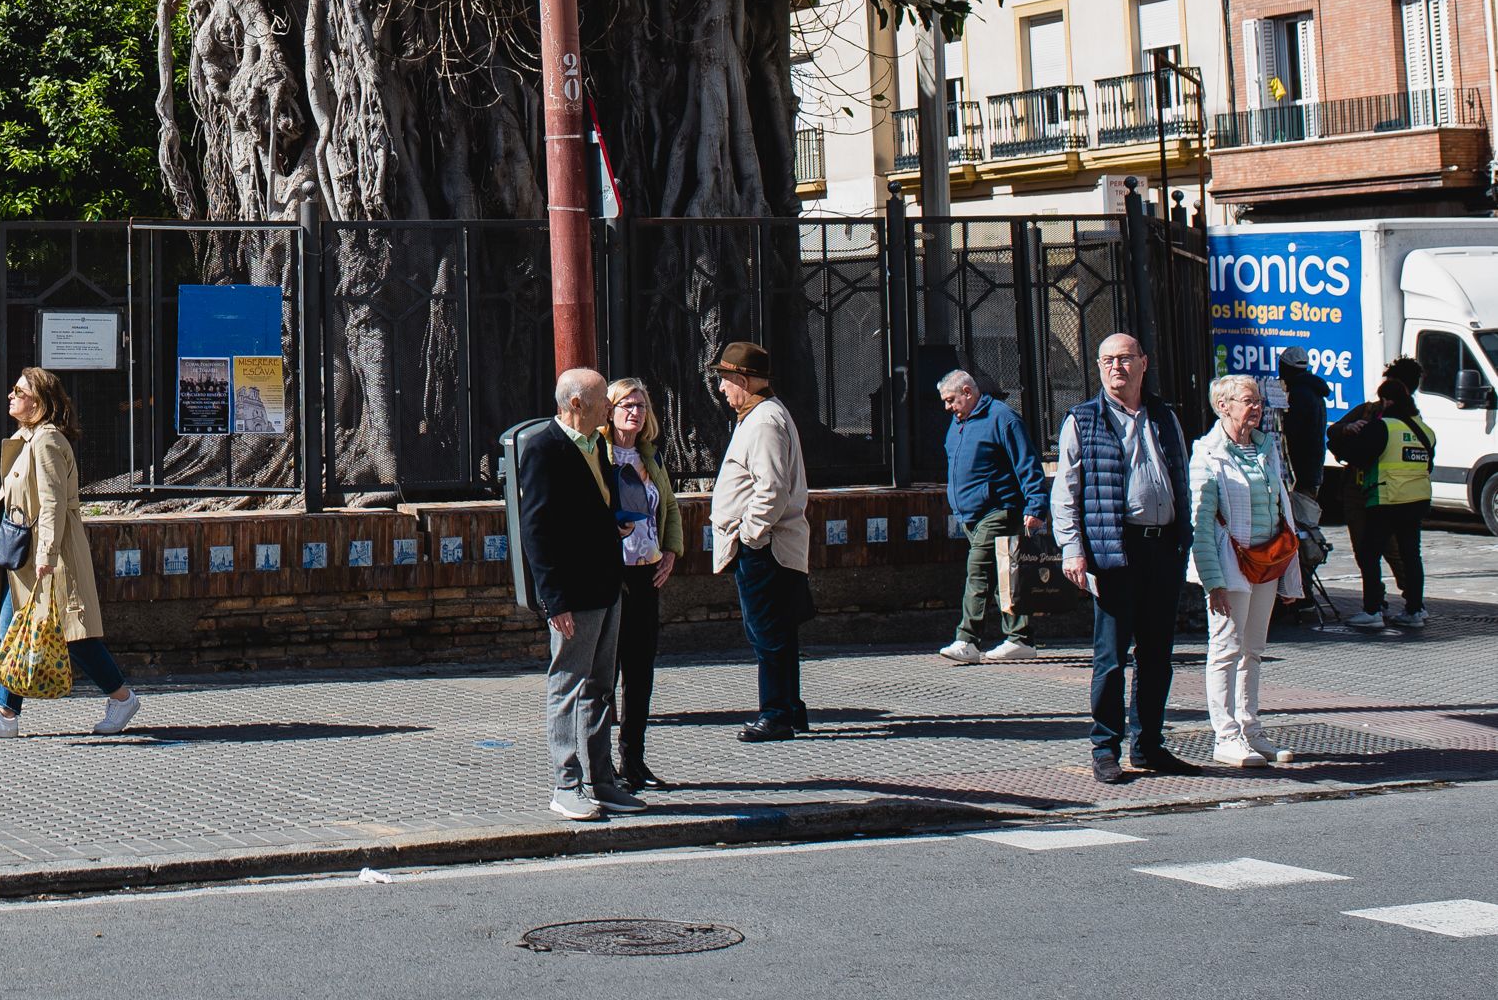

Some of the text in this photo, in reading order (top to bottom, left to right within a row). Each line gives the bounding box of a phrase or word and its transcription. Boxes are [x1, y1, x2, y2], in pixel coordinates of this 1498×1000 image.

[563, 53, 580, 101] 20
[1234, 300, 1286, 325] Hogar
[1289, 300, 1342, 323] Store
[1240, 328, 1259, 336] ULTRA
[1259, 328, 1279, 337] RADIO
[238, 358, 279, 366] MISERERE
[242, 368, 275, 376] ESLAVA
